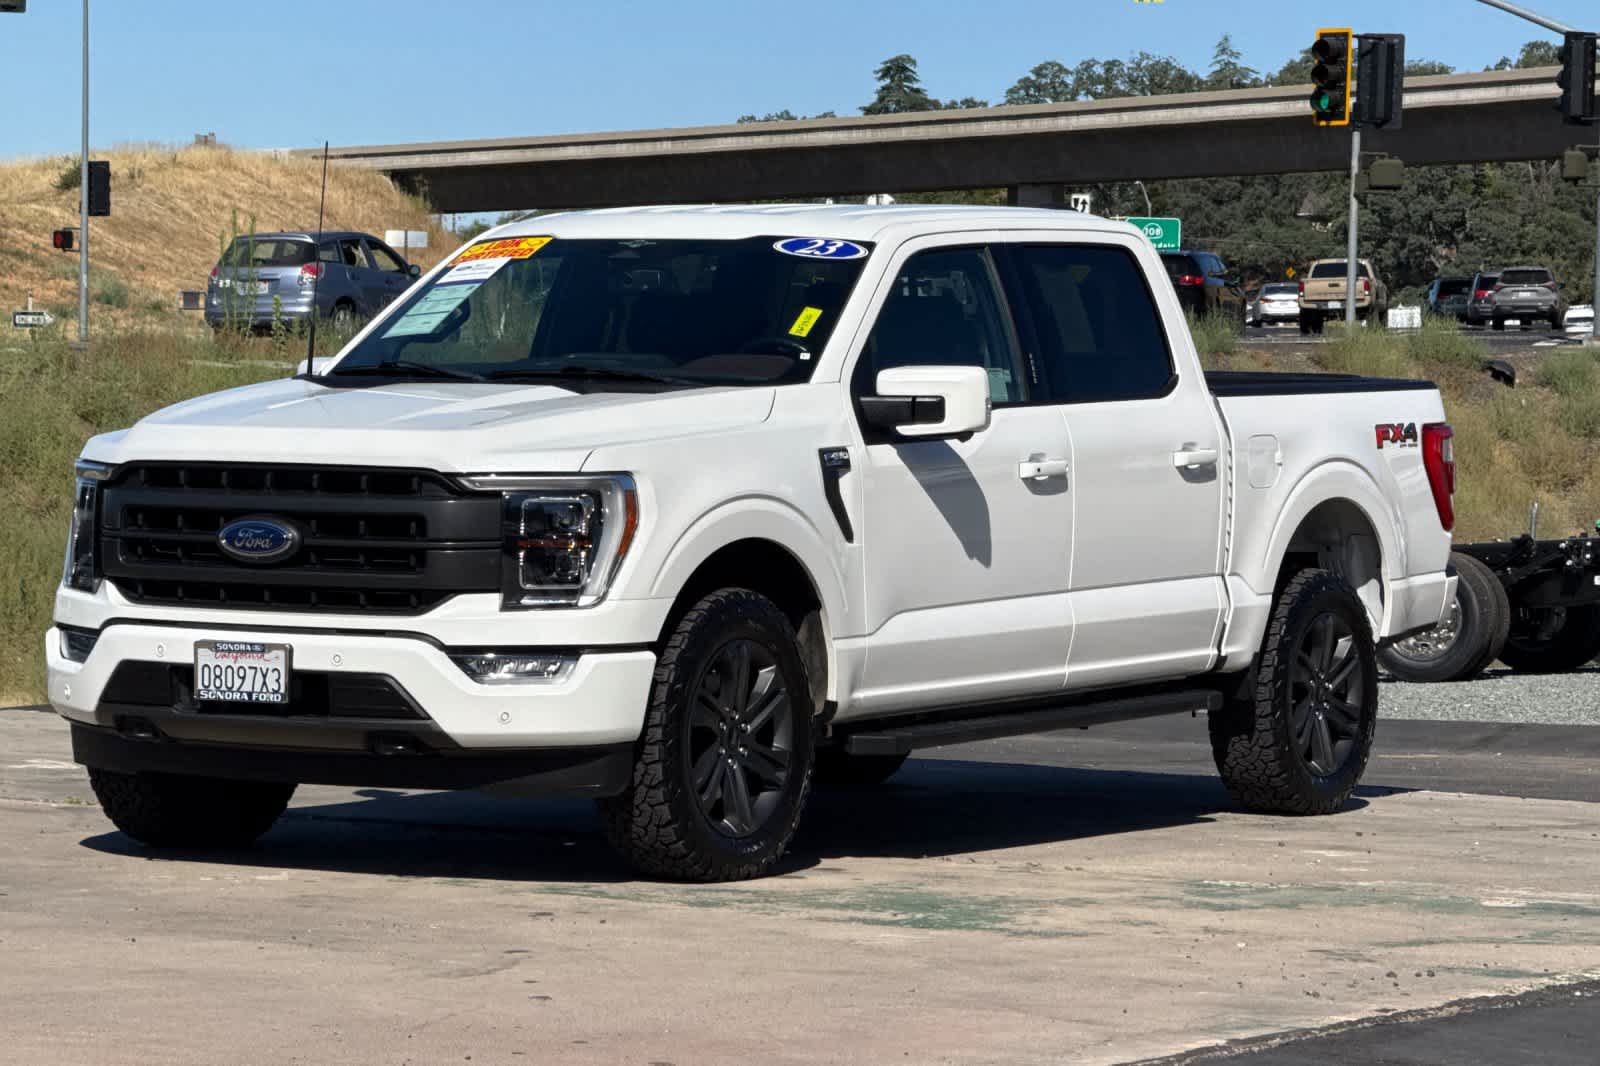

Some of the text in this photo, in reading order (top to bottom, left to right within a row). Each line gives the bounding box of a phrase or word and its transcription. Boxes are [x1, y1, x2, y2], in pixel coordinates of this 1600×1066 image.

[795, 240, 844, 255] 23
[1375, 422, 1417, 449] FX4
[234, 527, 275, 549] Ford
[216, 643, 251, 651] SONORA
[201, 663, 282, 693] 08097X3
[199, 690, 282, 701] SONORA FORD
